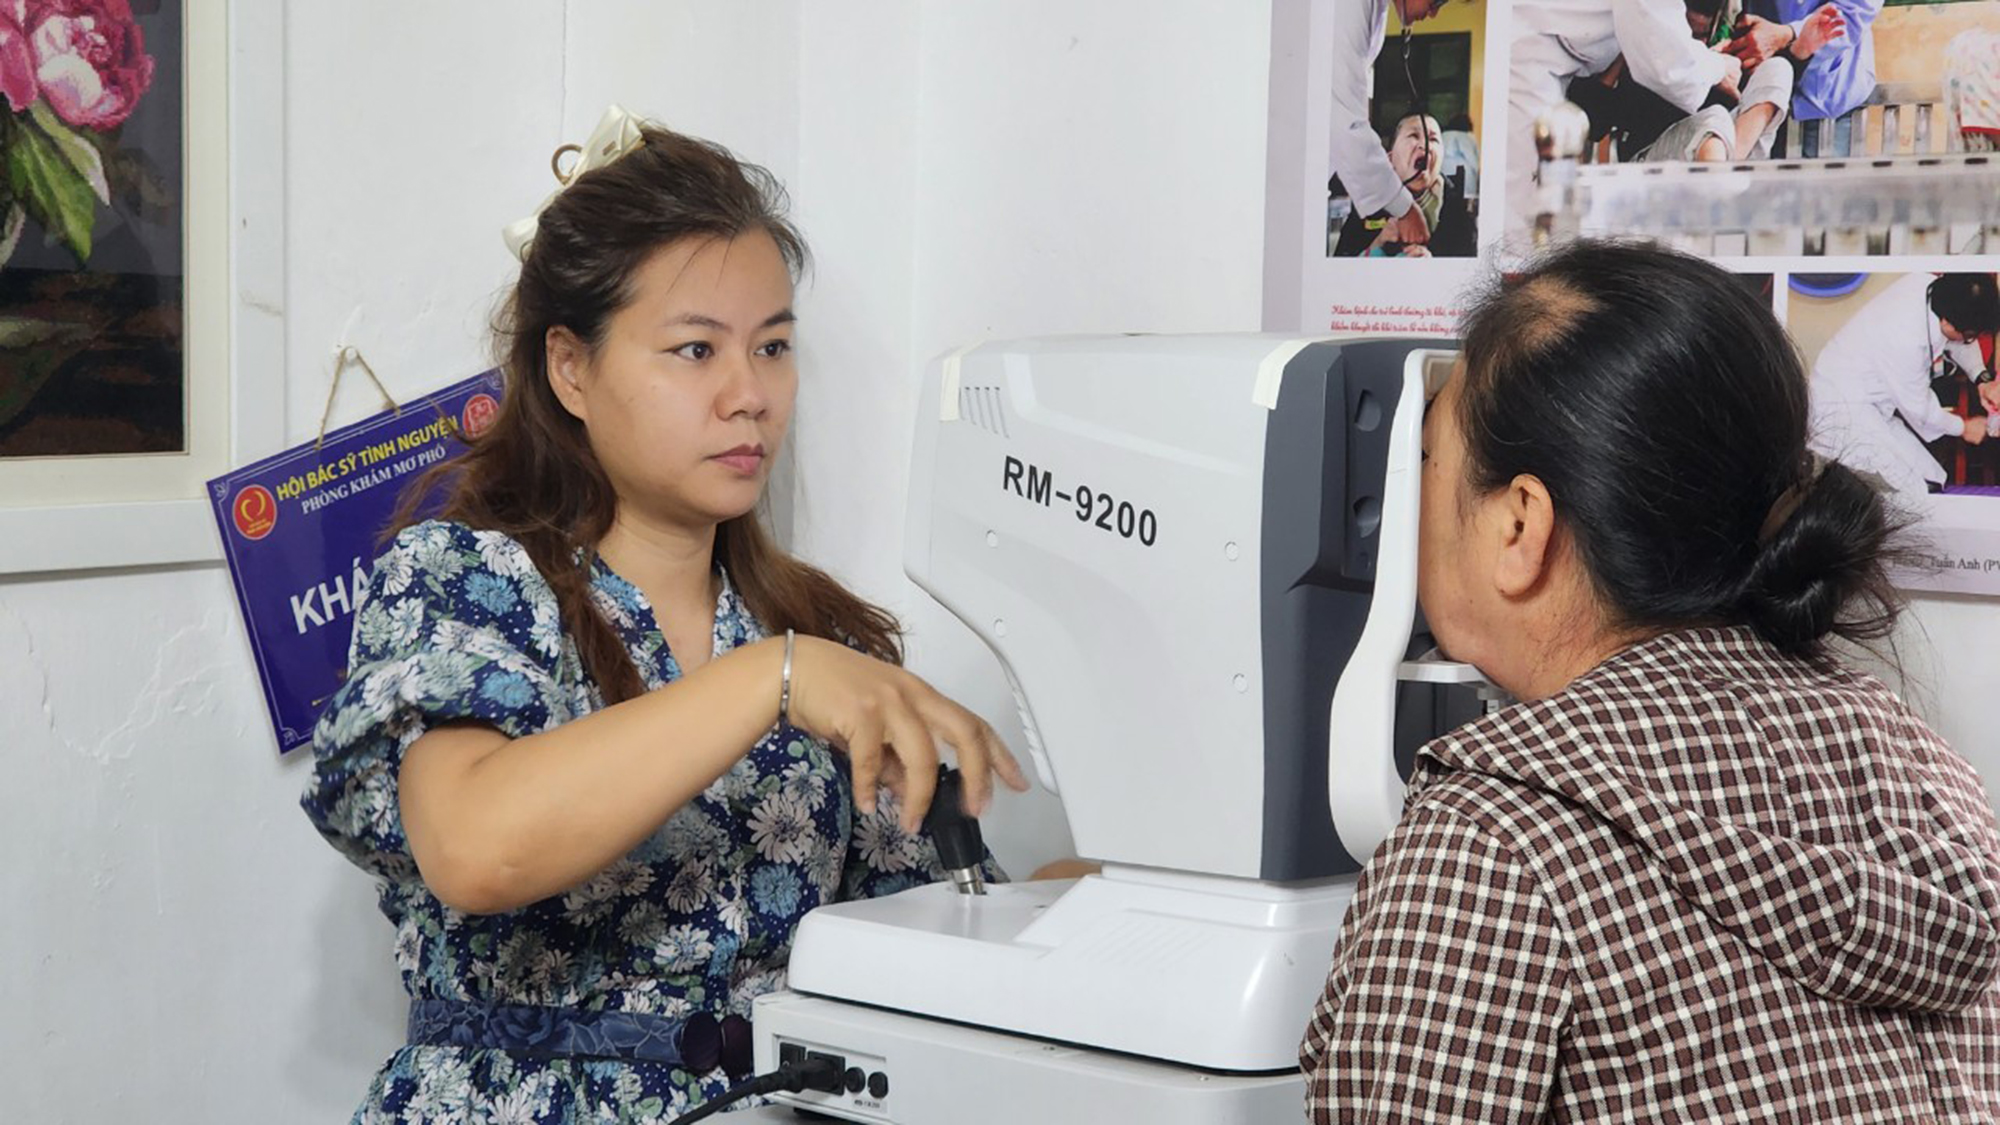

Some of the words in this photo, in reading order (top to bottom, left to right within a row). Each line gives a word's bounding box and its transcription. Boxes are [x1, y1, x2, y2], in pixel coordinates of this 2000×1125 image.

[276, 475, 306, 501] HỘI
[306, 463, 338, 489] BÁC
[338, 452, 357, 476] SỸ
[358, 439, 397, 467] TÌNH
[397, 415, 459, 452] NGUYỆN
[301, 484, 349, 514] PHÒNG
[349, 468, 392, 495] KHÁM
[1003, 455, 1157, 547] RM-9200
[1957, 558, 1980, 570] Anh
